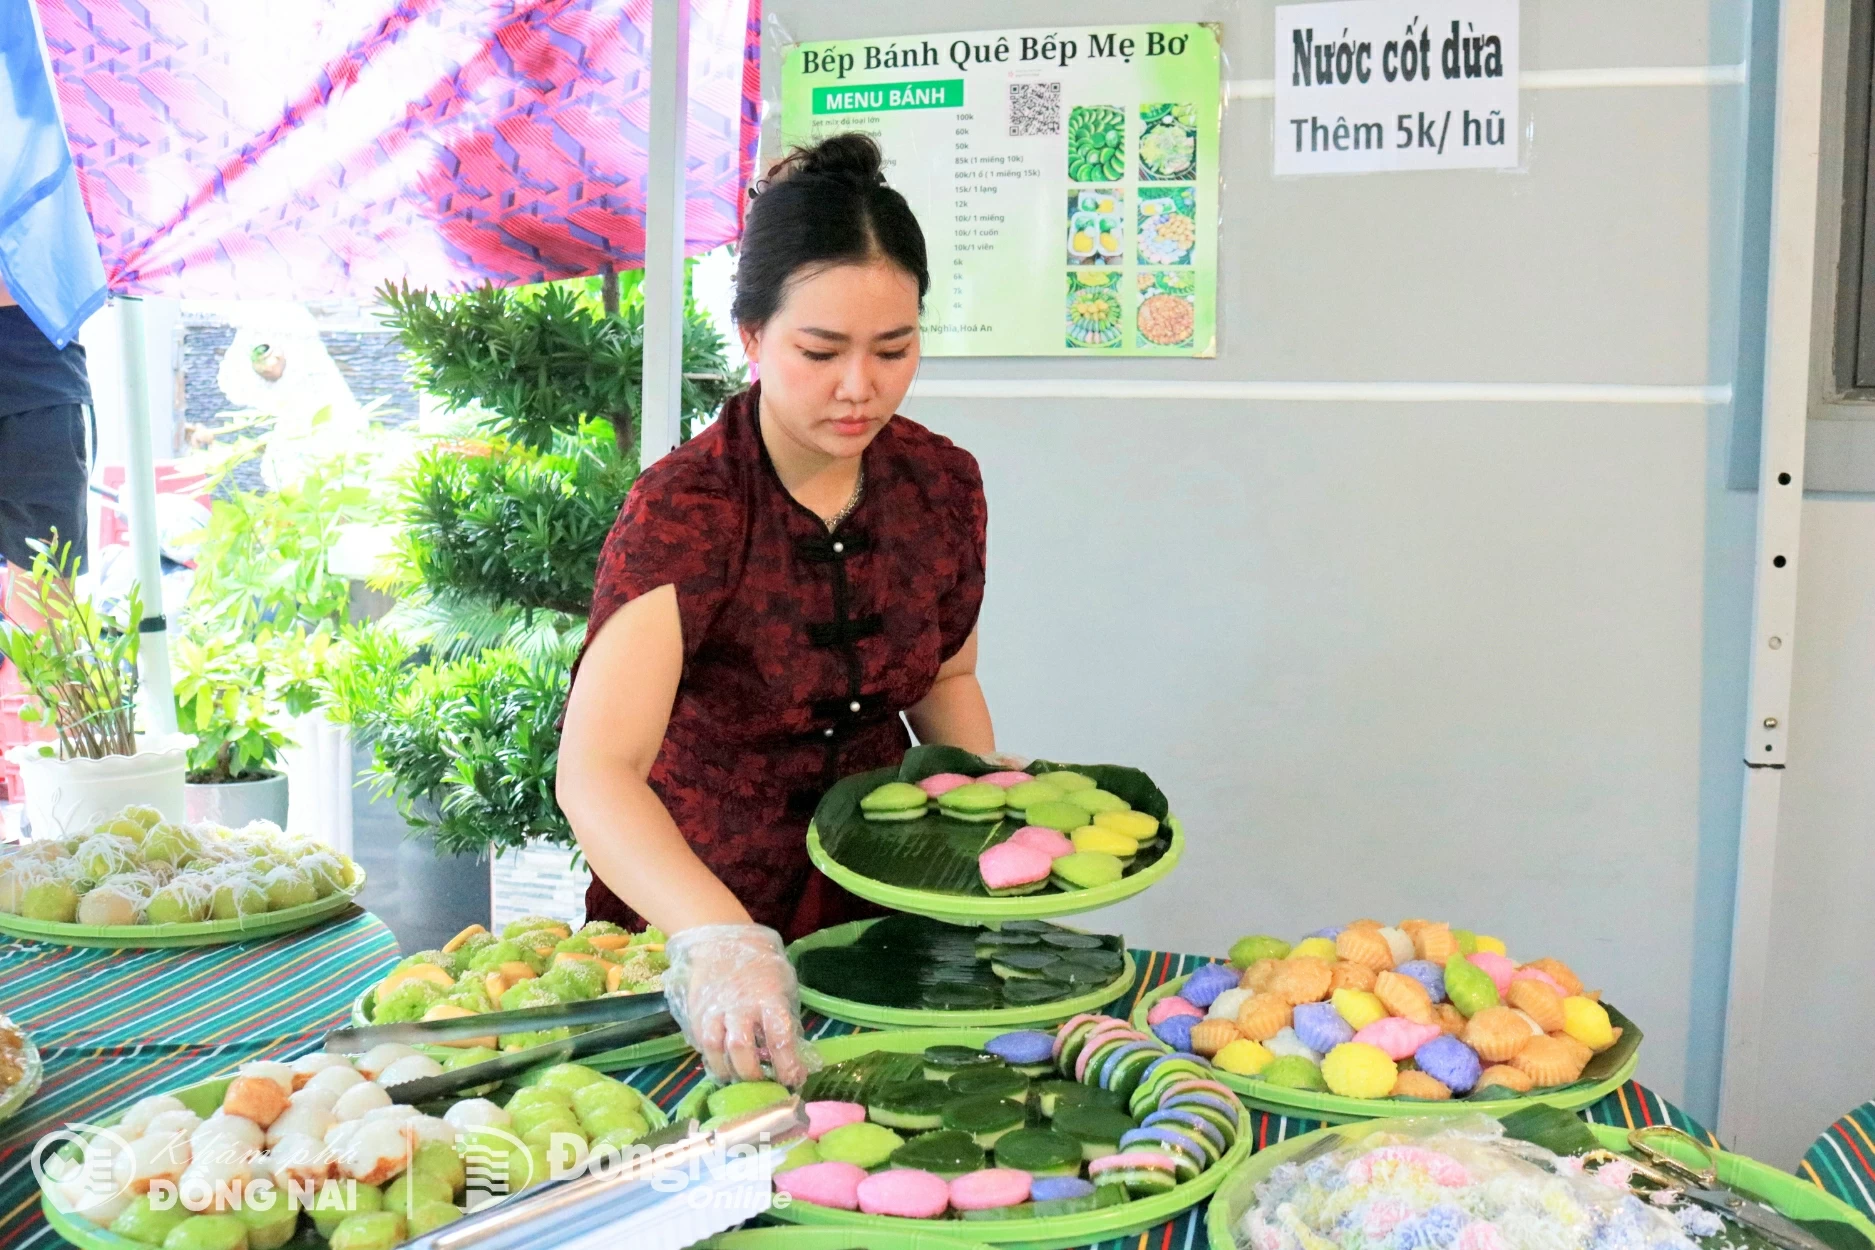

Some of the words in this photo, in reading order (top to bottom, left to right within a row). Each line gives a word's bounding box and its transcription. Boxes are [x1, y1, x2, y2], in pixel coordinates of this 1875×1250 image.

[802, 45, 854, 79] Bếp
[864, 42, 939, 70] Bánh
[950, 36, 1010, 72] Quê
[1019, 32, 1078, 67] Bếp
[1087, 33, 1135, 64] Mẹ
[1145, 31, 1189, 57] Bơ
[1292, 27, 1372, 87] Nước
[1383, 15, 1431, 83] cốt
[1442, 20, 1503, 80] dừa
[826, 90, 884, 111] MENU
[889, 85, 946, 107] BÁNH
[956, 113, 974, 121] 100k
[955, 128, 969, 136] 60k
[1290, 116, 1384, 153] Thêm
[1396, 110, 1452, 155] 5k/
[1463, 110, 1505, 147] hũ
[955, 142, 969, 150] 50k
[955, 156, 969, 165] 85k
[970, 156, 978, 165] (1
[980, 155, 1005, 165] miếng
[1007, 155, 1024, 164] 10k)
[954, 171, 976, 179] 60k/1
[996, 169, 1021, 179] miếng
[1023, 169, 1041, 178] 15k)
[955, 186, 972, 194] 15k/
[980, 185, 998, 195] lạng
[954, 200, 968, 208] 12k
[954, 215, 972, 223] 10k/
[979, 213, 1005, 223] miếng
[954, 229, 972, 237] 10k/
[954, 243, 975, 251] 10k/1
[953, 258, 963, 266] 6k
[980, 324, 993, 333] An
